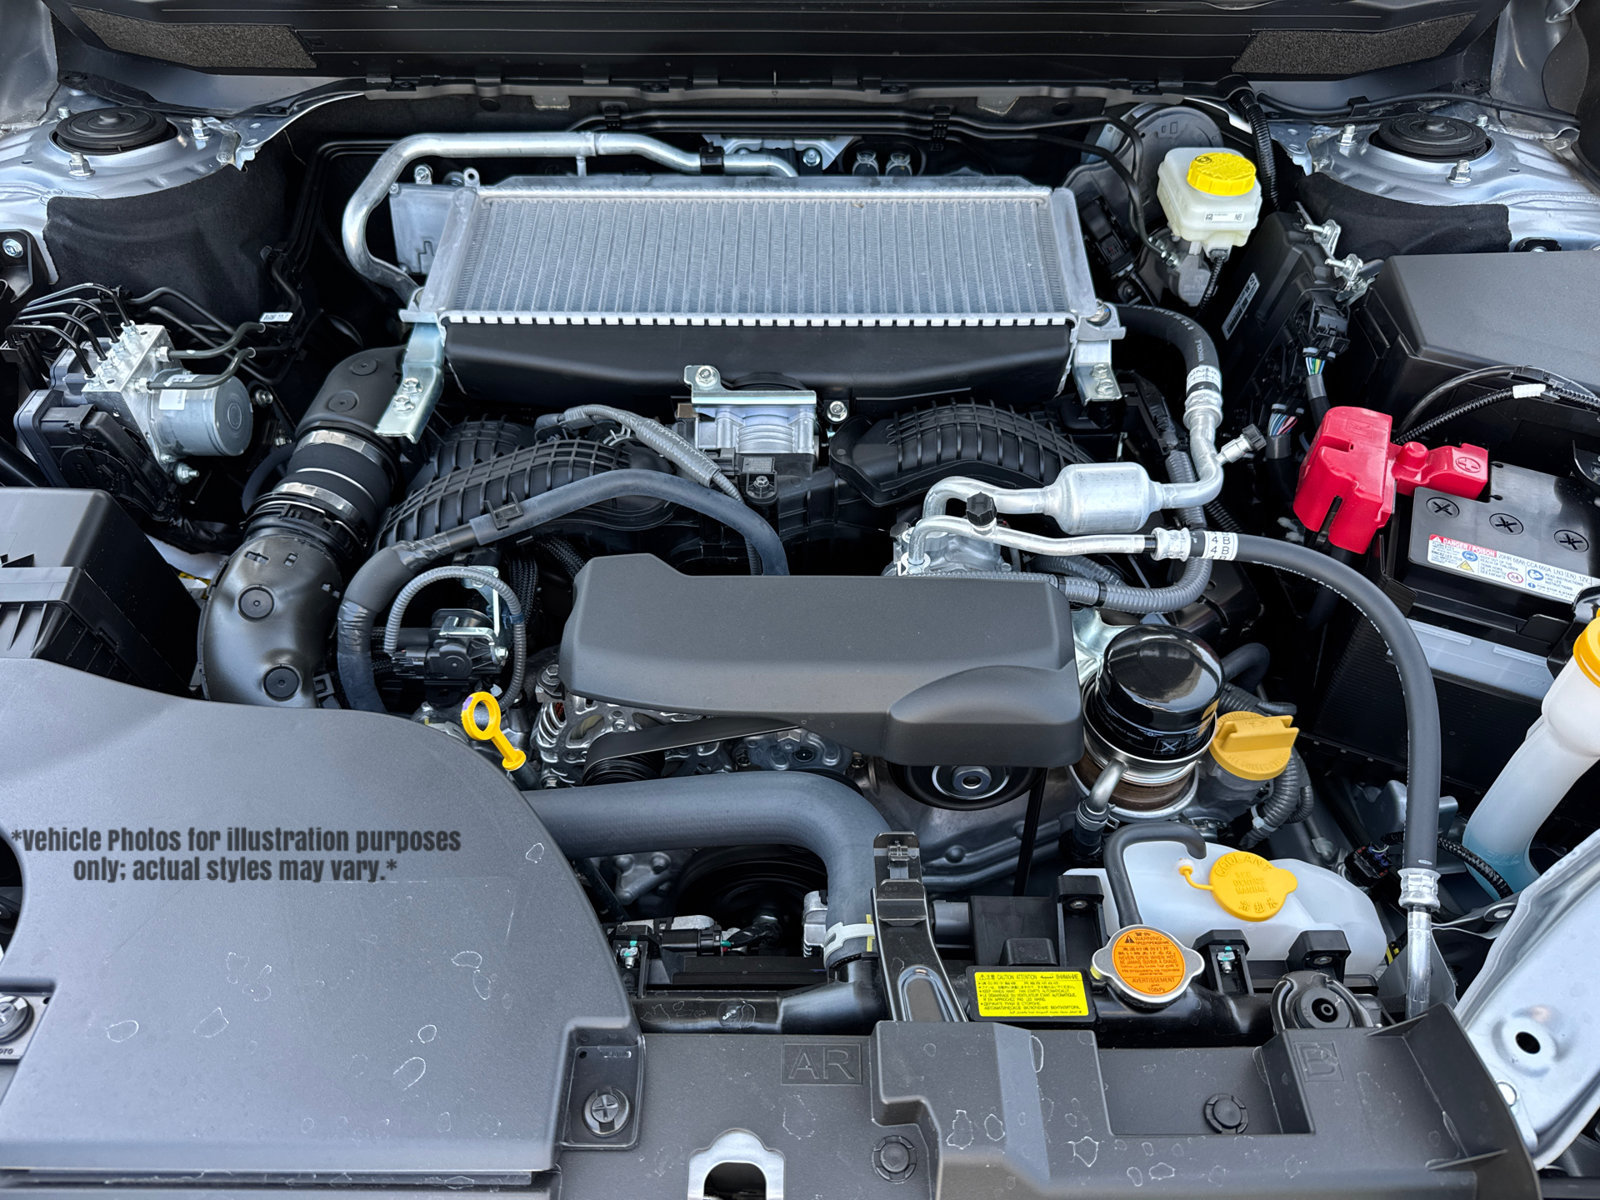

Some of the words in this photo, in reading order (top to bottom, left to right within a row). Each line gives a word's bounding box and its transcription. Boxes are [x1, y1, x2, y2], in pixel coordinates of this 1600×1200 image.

[1210, 546, 1218, 554] 4
[1221, 546, 1230, 555] B
[1211, 536, 1218, 544] 4
[1223, 536, 1231, 545] B
[1443, 537, 1468, 550] DANGER
[1472, 545, 1495, 557] POISON
[1215, 854, 1273, 878] COOLANT
[788, 1047, 856, 1080] AR
